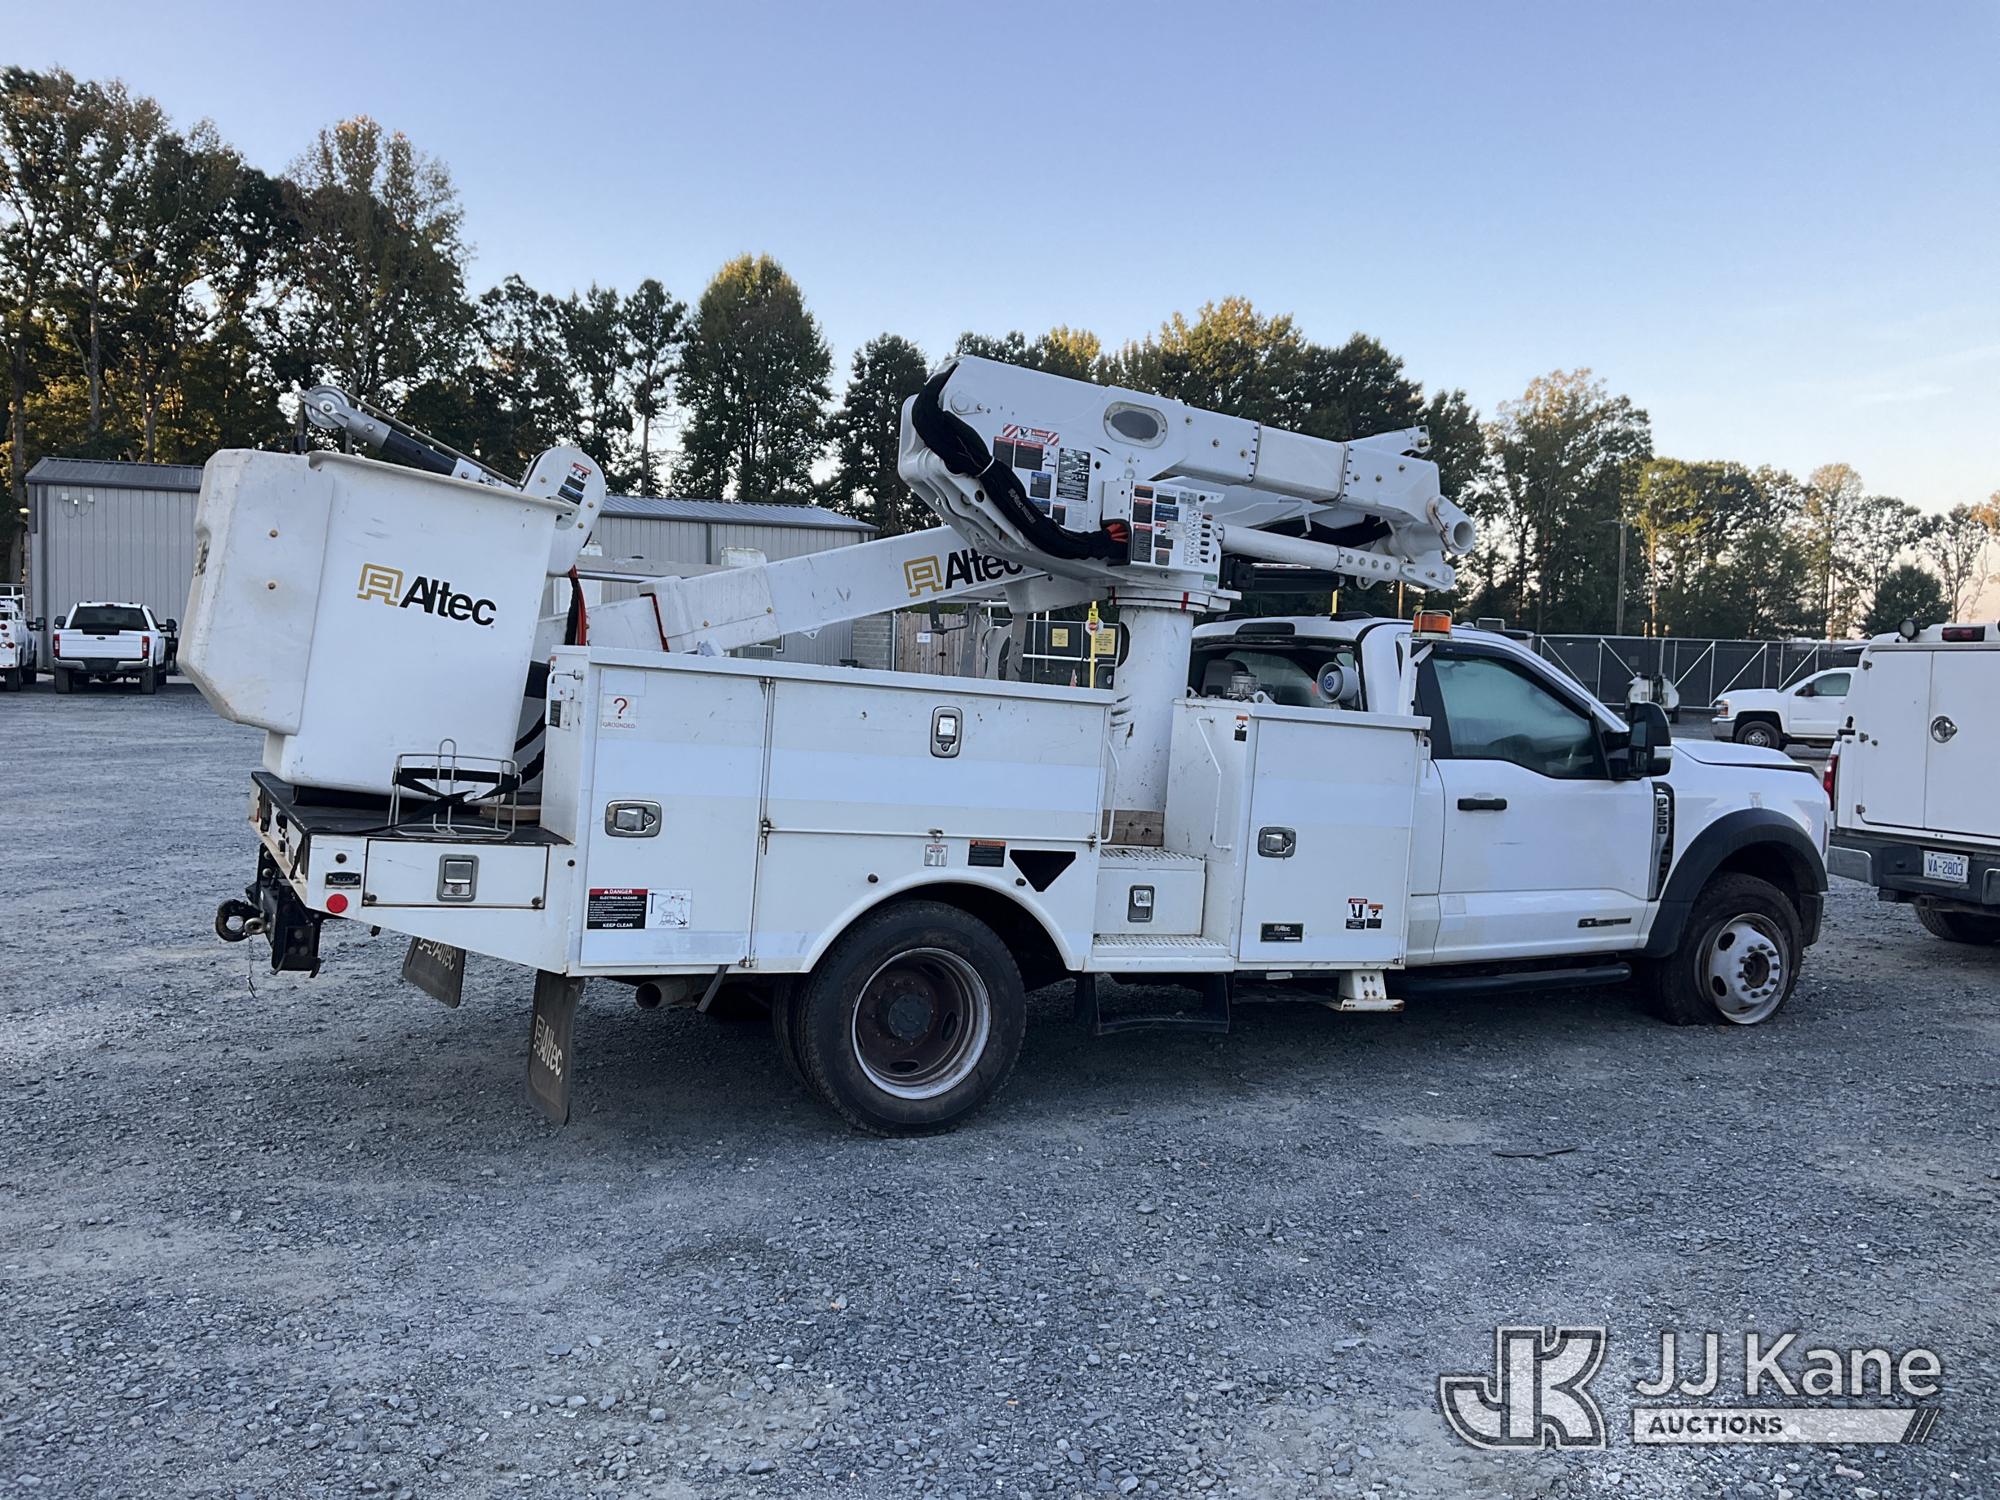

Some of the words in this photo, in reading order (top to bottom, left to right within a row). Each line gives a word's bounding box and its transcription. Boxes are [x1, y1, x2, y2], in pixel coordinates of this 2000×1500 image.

[400, 576, 496, 625] Altec
[1927, 859, 1964, 877] VA-2803
[540, 1025, 563, 1076] Altec
